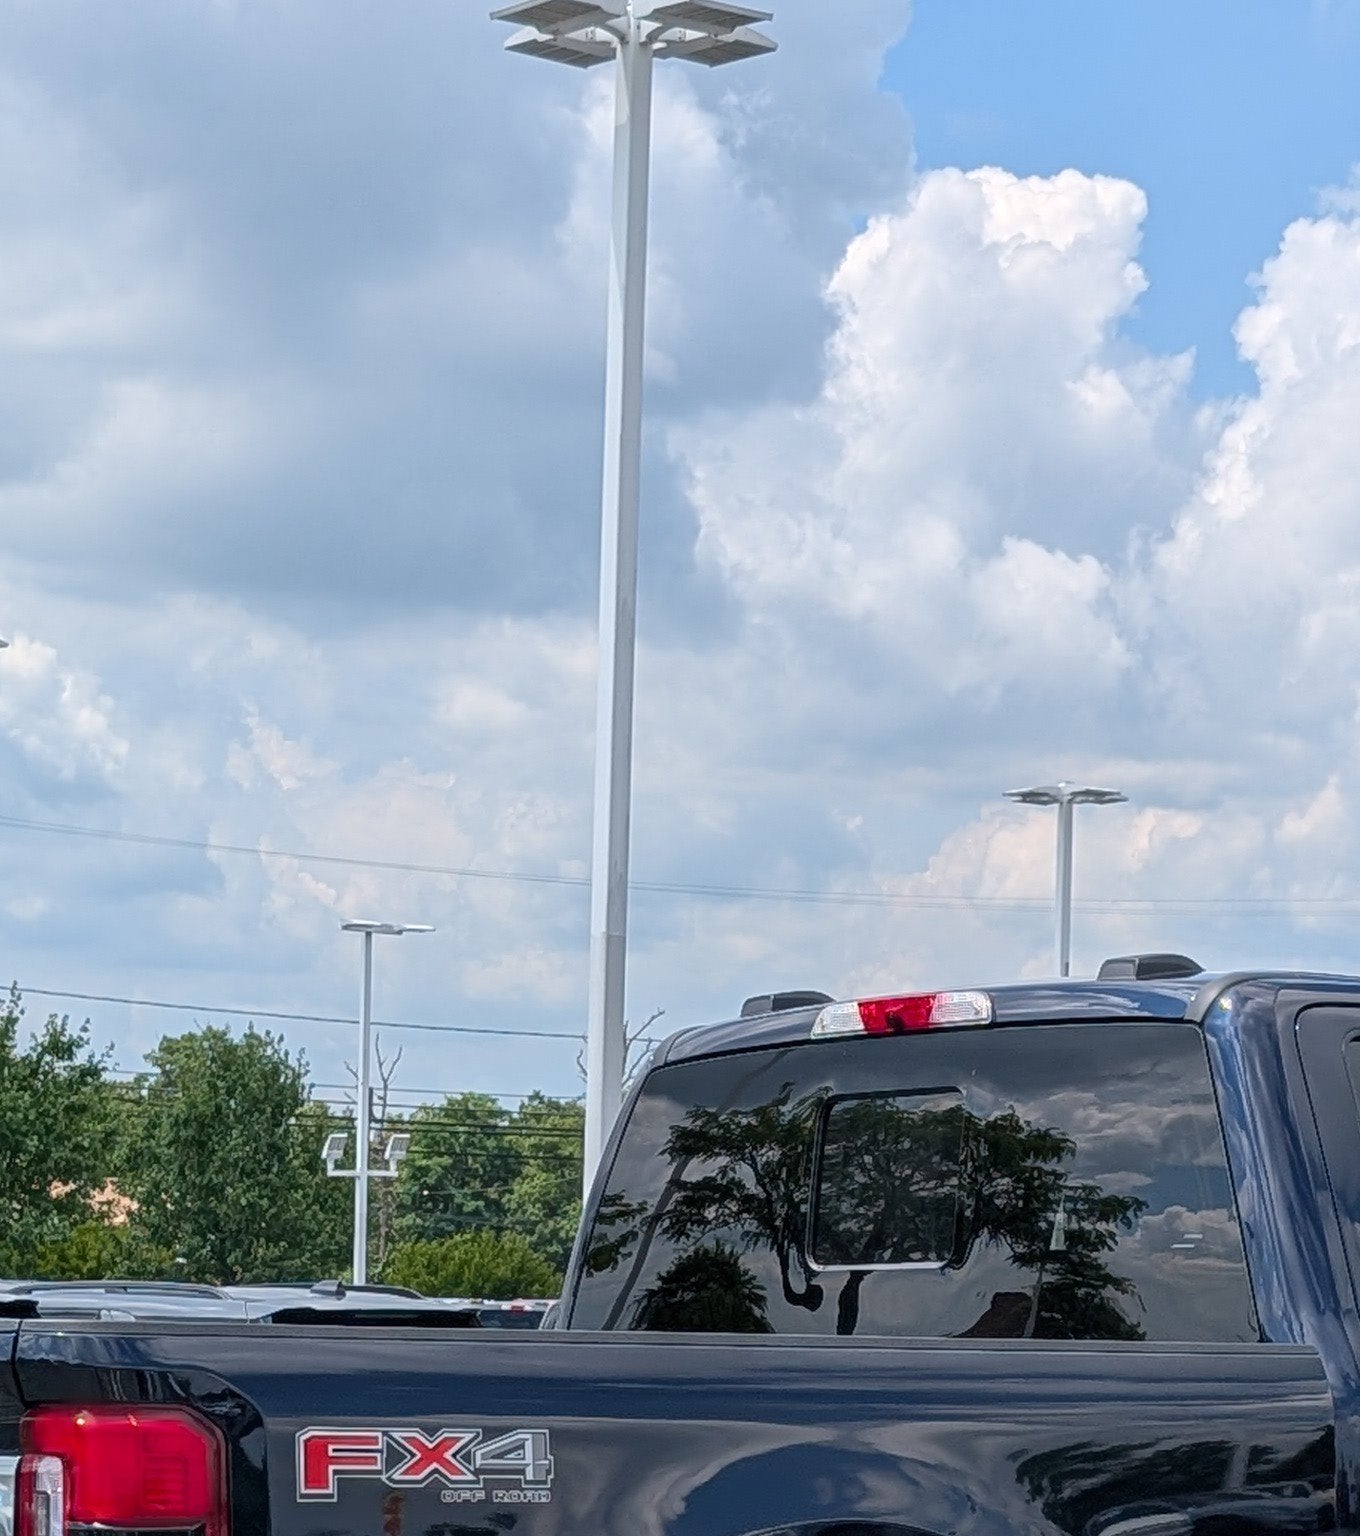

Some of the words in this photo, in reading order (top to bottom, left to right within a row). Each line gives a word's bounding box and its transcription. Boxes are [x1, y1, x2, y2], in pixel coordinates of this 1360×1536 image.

[296, 1427, 554, 1502] FX4
[441, 1489, 486, 1503] OFF
[493, 1489, 551, 1503] ROAD
